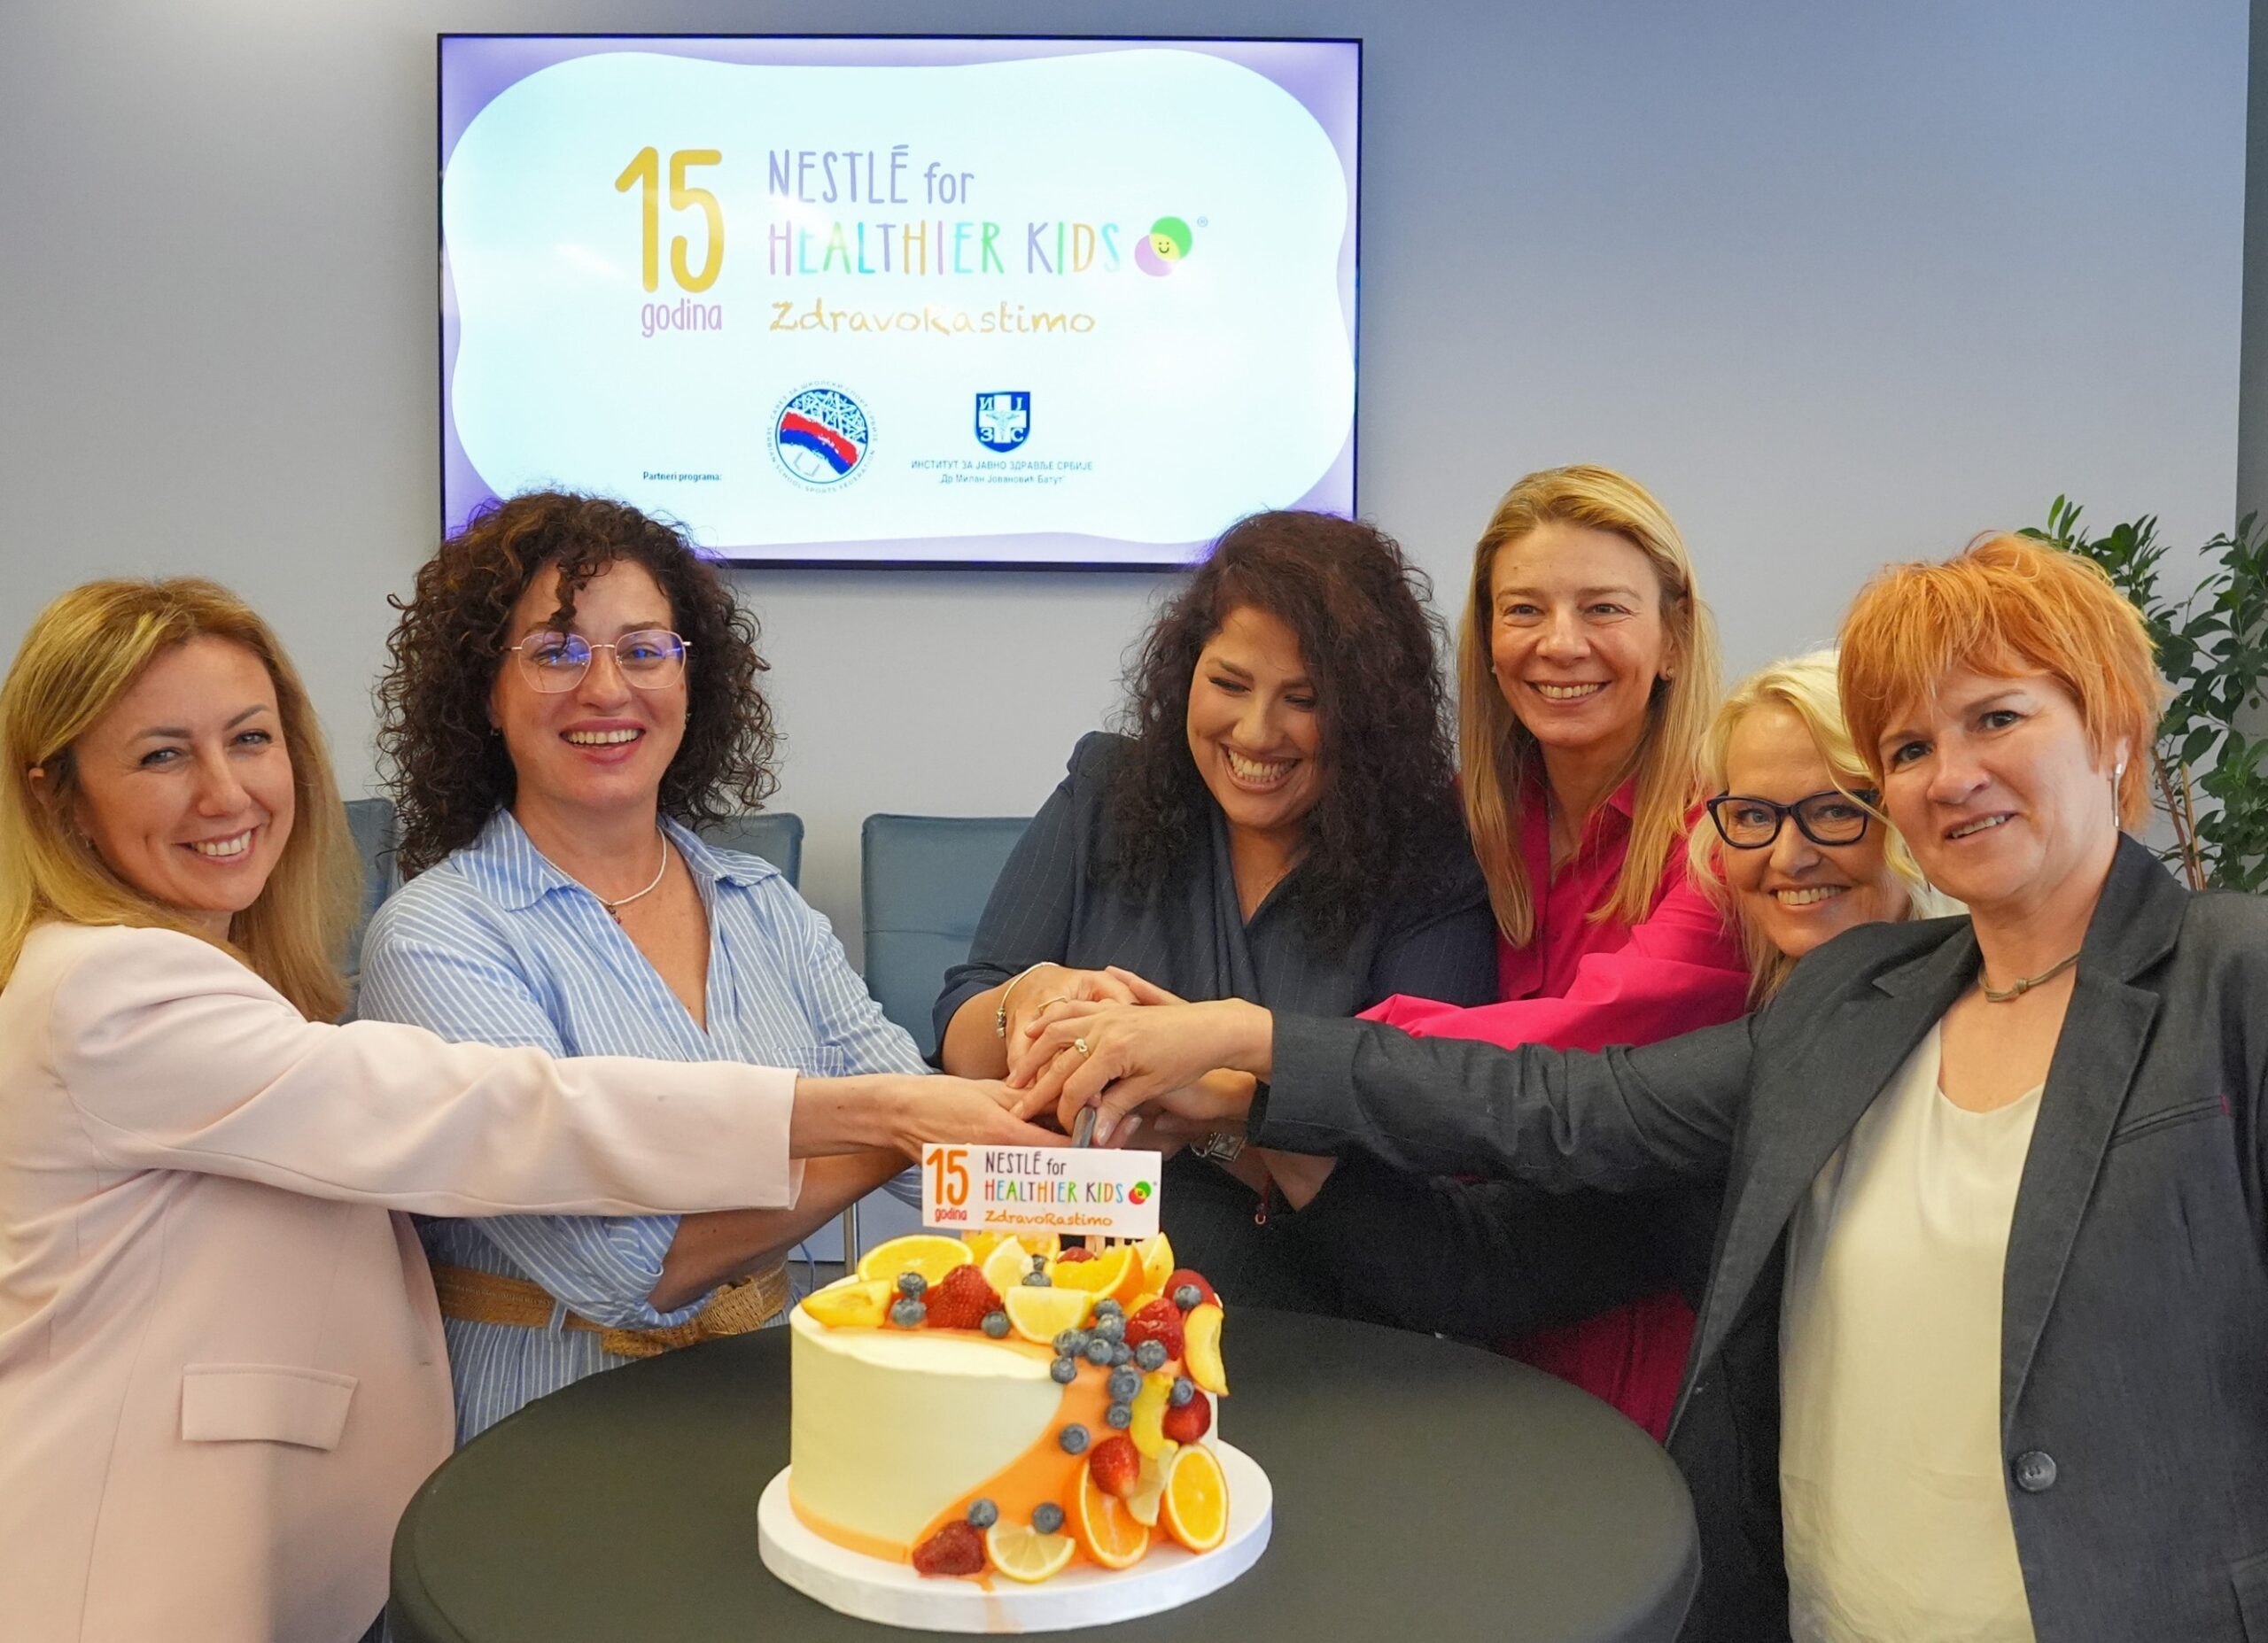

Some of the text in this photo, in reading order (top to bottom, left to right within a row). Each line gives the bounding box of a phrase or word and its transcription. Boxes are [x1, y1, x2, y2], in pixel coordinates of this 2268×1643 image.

[769, 145, 975, 205] NESTLÉ for
[615, 146, 726, 294] 15
[769, 220, 1121, 277] HEALTHIER KIDS
[641, 298, 723, 338] godina
[643, 471, 722, 484] Partneri programa:
[911, 460, 959, 469] ИНСТИТУТ
[962, 460, 974, 469] ЗА
[1010, 461, 1054, 471] ЗДРАВЉЕ
[1057, 461, 1093, 471] СРБИЈЕ
[986, 1151, 1068, 1176] NESTLÉ for
[926, 1148, 968, 1206] 15
[985, 1179, 1123, 1204] HEALTHIER KIDS
[935, 1208, 968, 1222] godina
[985, 1210, 1114, 1227] ZdravoRastimo
